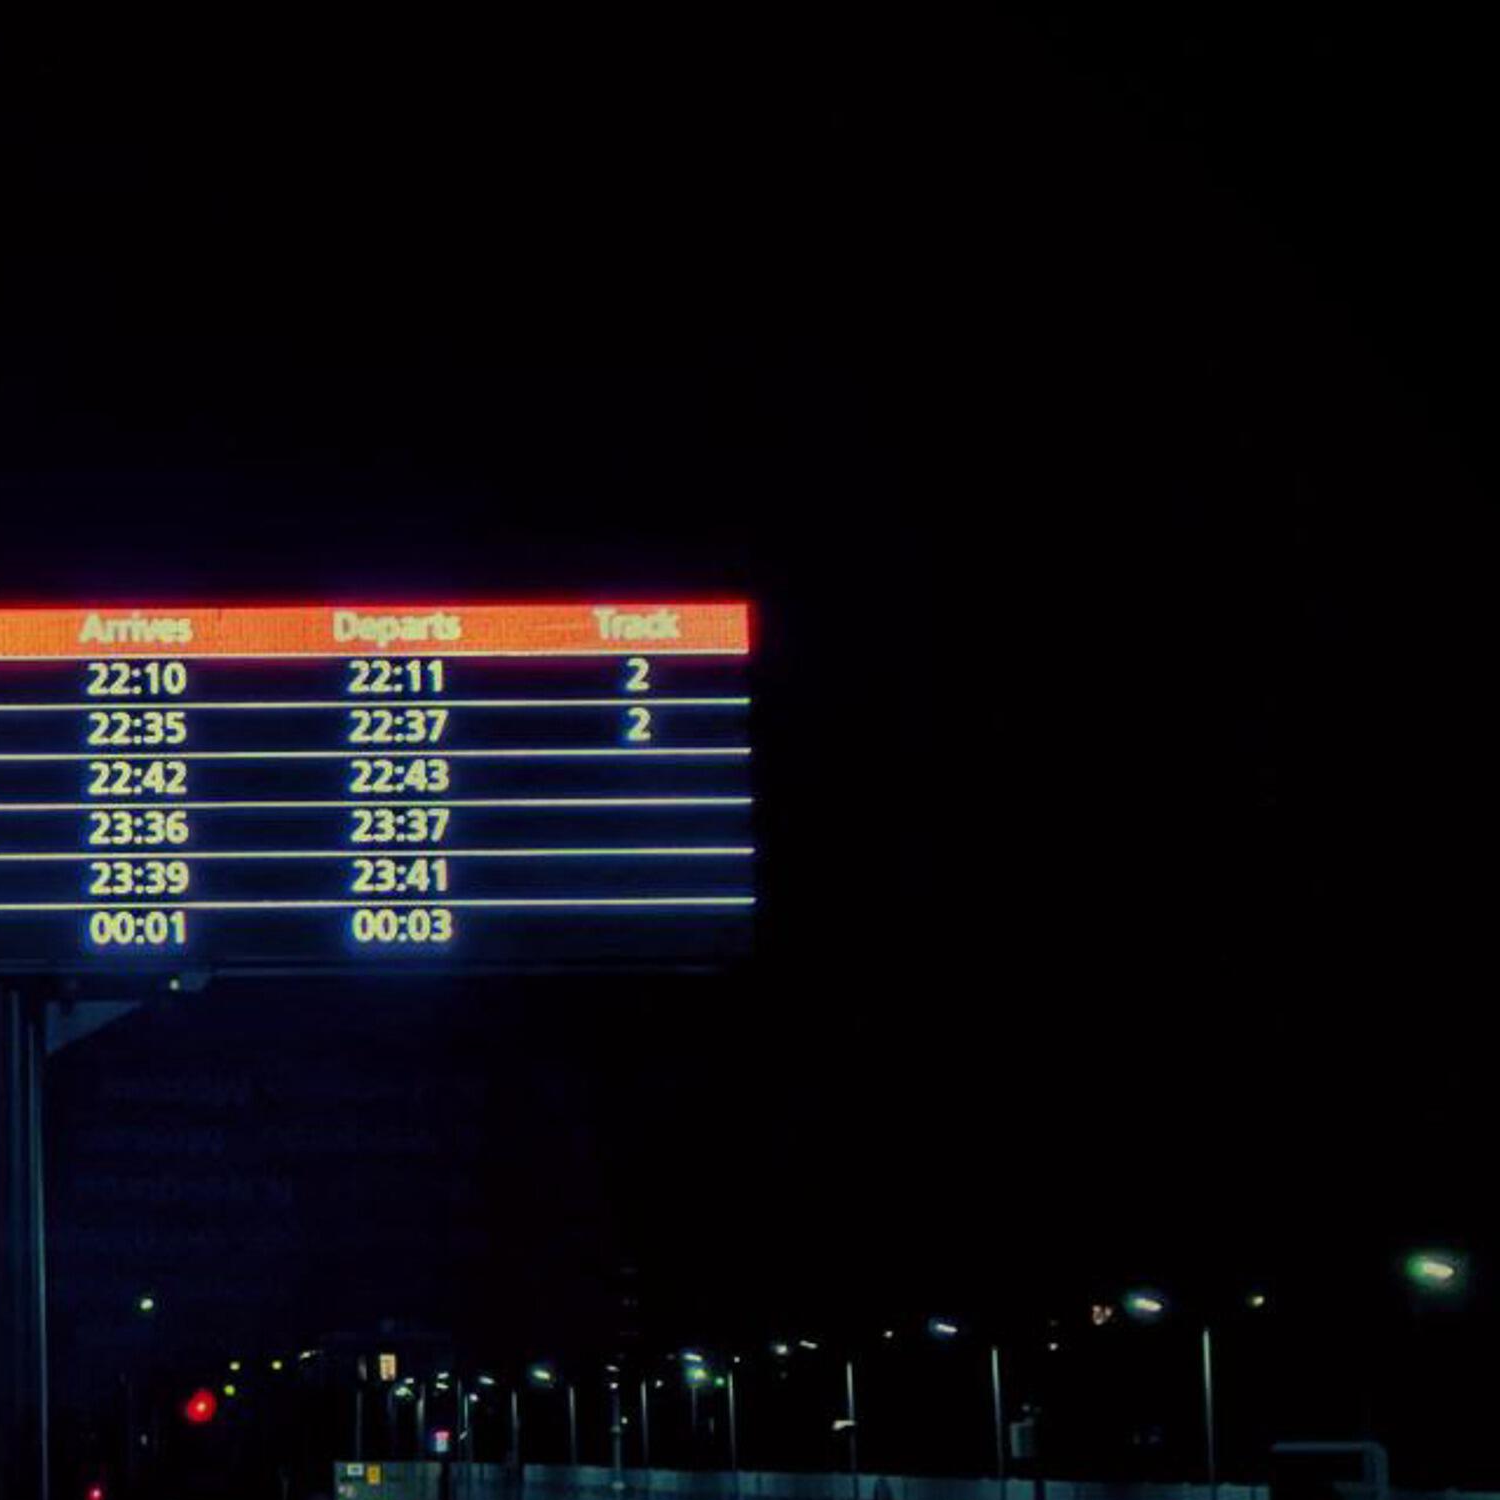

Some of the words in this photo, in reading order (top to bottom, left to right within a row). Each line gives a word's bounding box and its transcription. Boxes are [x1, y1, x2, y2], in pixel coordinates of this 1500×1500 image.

[79, 613, 193, 643] Arrives
[333, 611, 462, 648] Departs
[593, 607, 681, 640] Track
[86, 661, 187, 696] 22:10
[347, 655, 443, 694] 22:11
[625, 657, 650, 692] 2
[87, 711, 187, 746] 22:35
[348, 708, 449, 743] 22:37
[626, 706, 651, 742] 2
[87, 760, 187, 796] 22:42
[349, 755, 450, 793] 22:43
[88, 810, 189, 845] 23:36
[350, 808, 450, 843] 23:37
[88, 860, 190, 895] 23:39
[350, 858, 447, 893] 23:41
[88, 910, 186, 945] 00:01
[351, 908, 453, 943] 00:03
